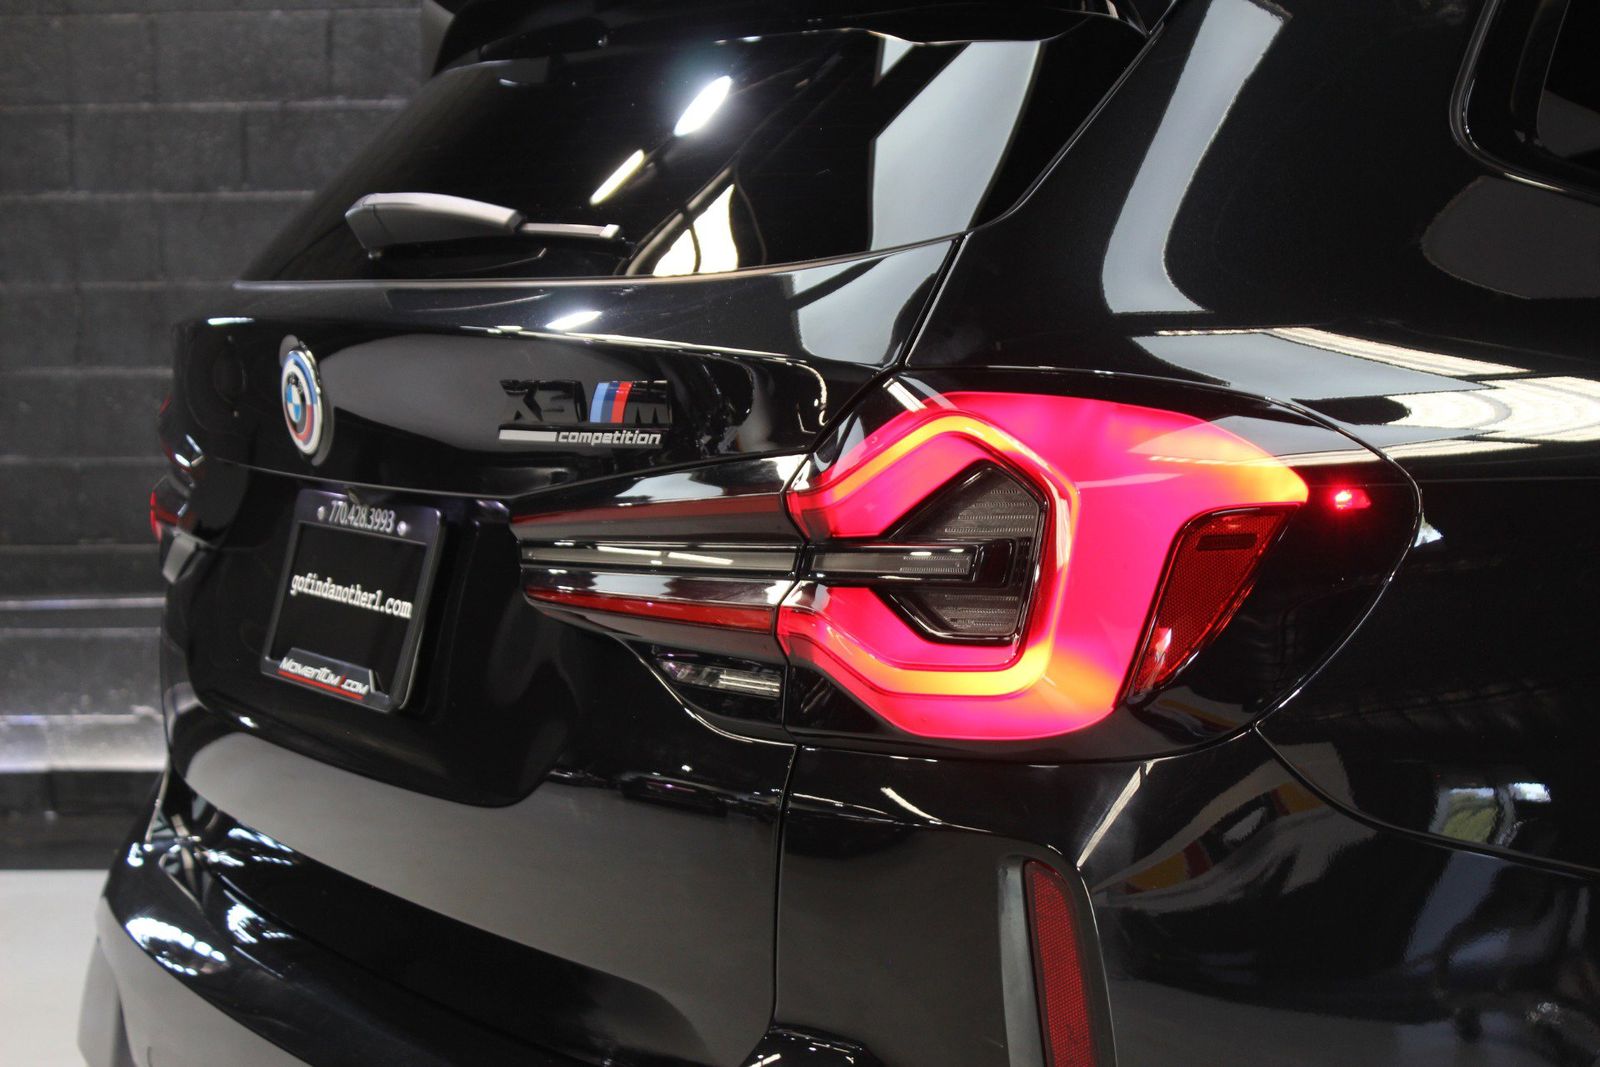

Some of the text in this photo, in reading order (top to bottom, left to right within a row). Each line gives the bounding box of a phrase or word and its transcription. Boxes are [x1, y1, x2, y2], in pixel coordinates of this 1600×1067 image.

[500, 379, 672, 423] X3 M
[558, 430, 662, 446] competition
[328, 500, 396, 533] 770.428.3993
[290, 573, 412, 619] gofindanother1.com
